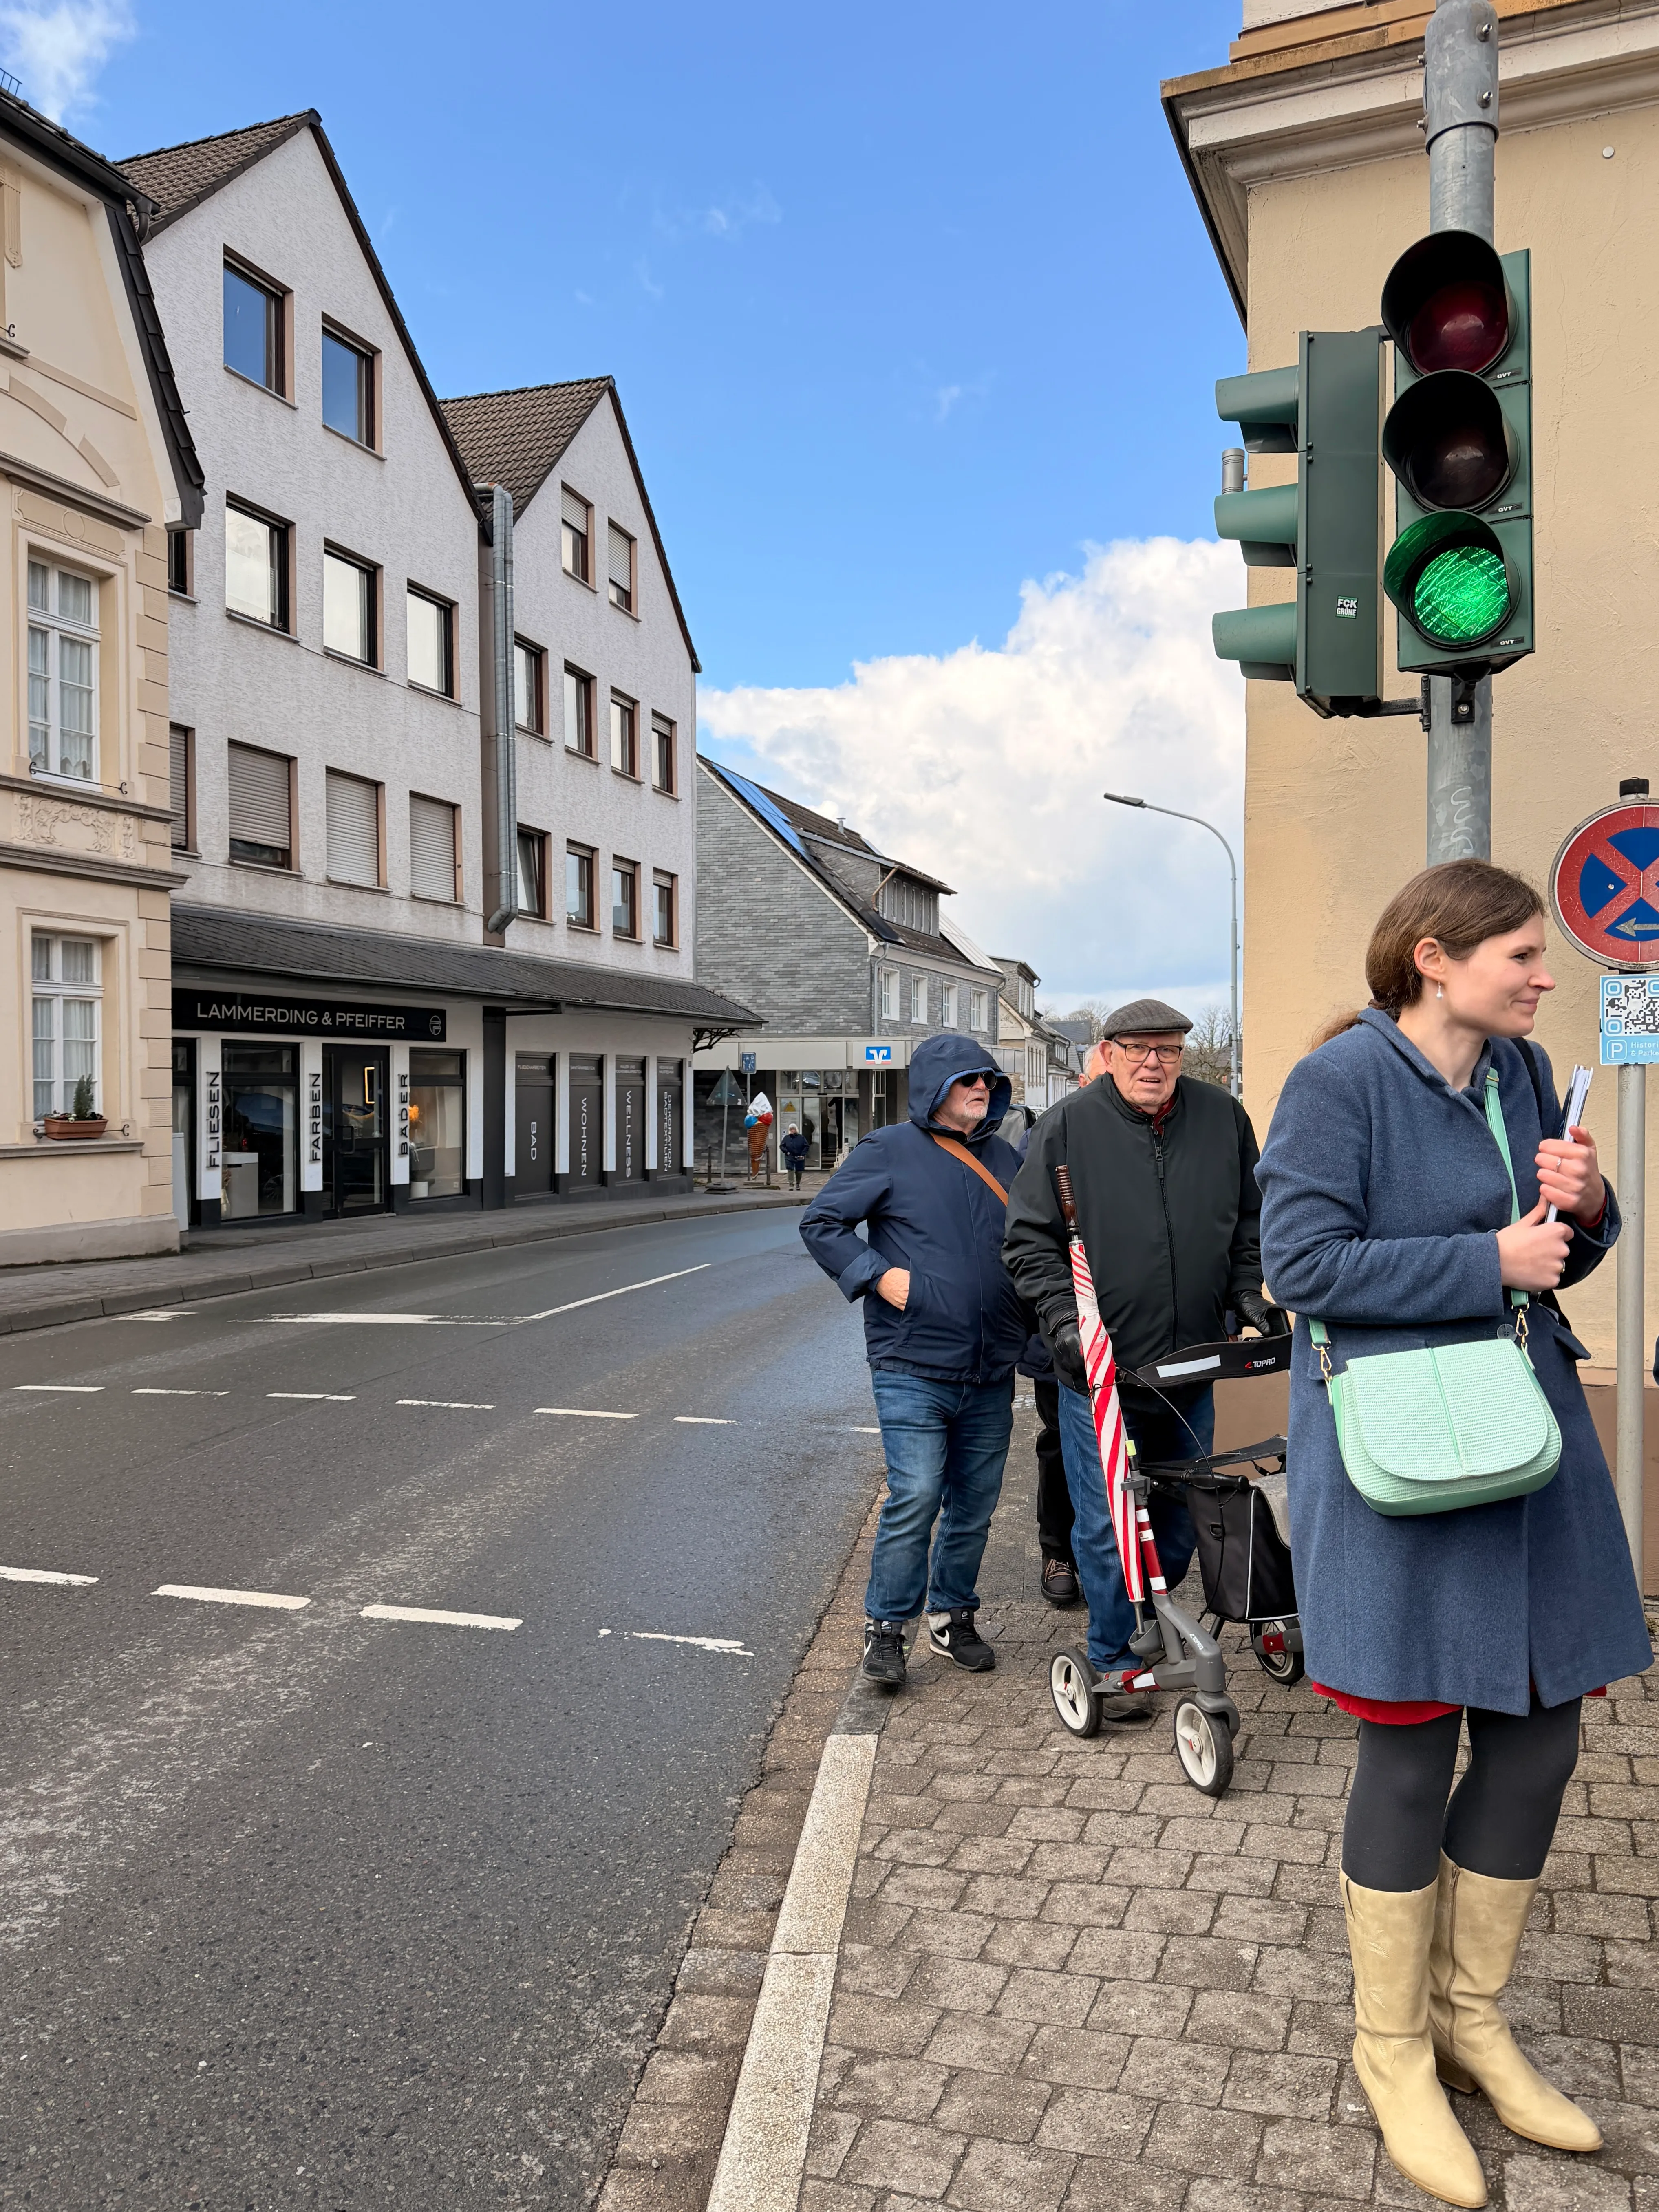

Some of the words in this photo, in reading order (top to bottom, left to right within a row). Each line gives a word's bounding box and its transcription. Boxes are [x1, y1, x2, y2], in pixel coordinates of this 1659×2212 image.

[1337, 598, 1357, 608] FCK
[1337, 607, 1356, 616] GRÜNE
[197, 1003, 318, 1024] LAMMERDING
[322, 1012, 332, 1025] &
[336, 1013, 405, 1029] PFEIFFER
[208, 1072, 220, 1167] FLIESEN
[311, 1073, 321, 1161] FARBEN
[399, 1074, 408, 1155] BÄDER
[1253, 1357, 1275, 1368] TOPRO
